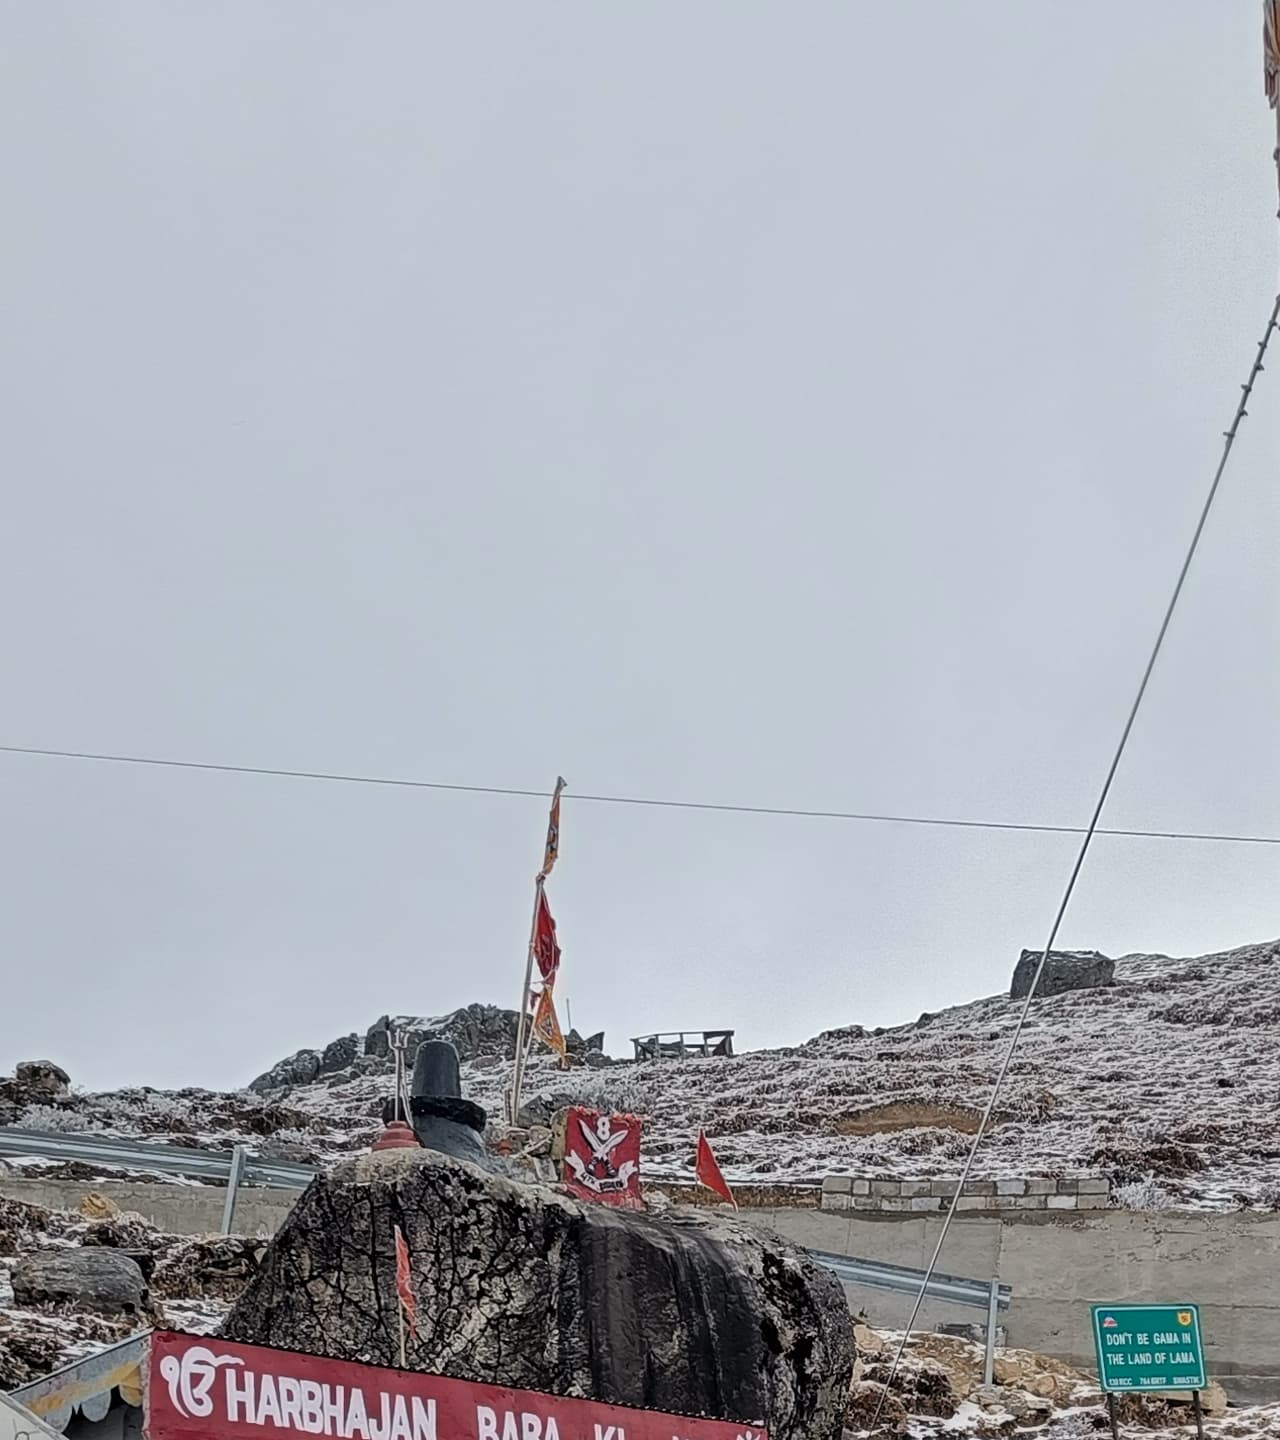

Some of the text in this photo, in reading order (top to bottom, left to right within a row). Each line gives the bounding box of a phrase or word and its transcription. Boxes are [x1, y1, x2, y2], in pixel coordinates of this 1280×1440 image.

[597, 1116, 610, 1140] 8
[1106, 1331, 1192, 1346] DON'T BE GAMA IN
[1106, 1351, 1195, 1366] THE LAND OF LAMA
